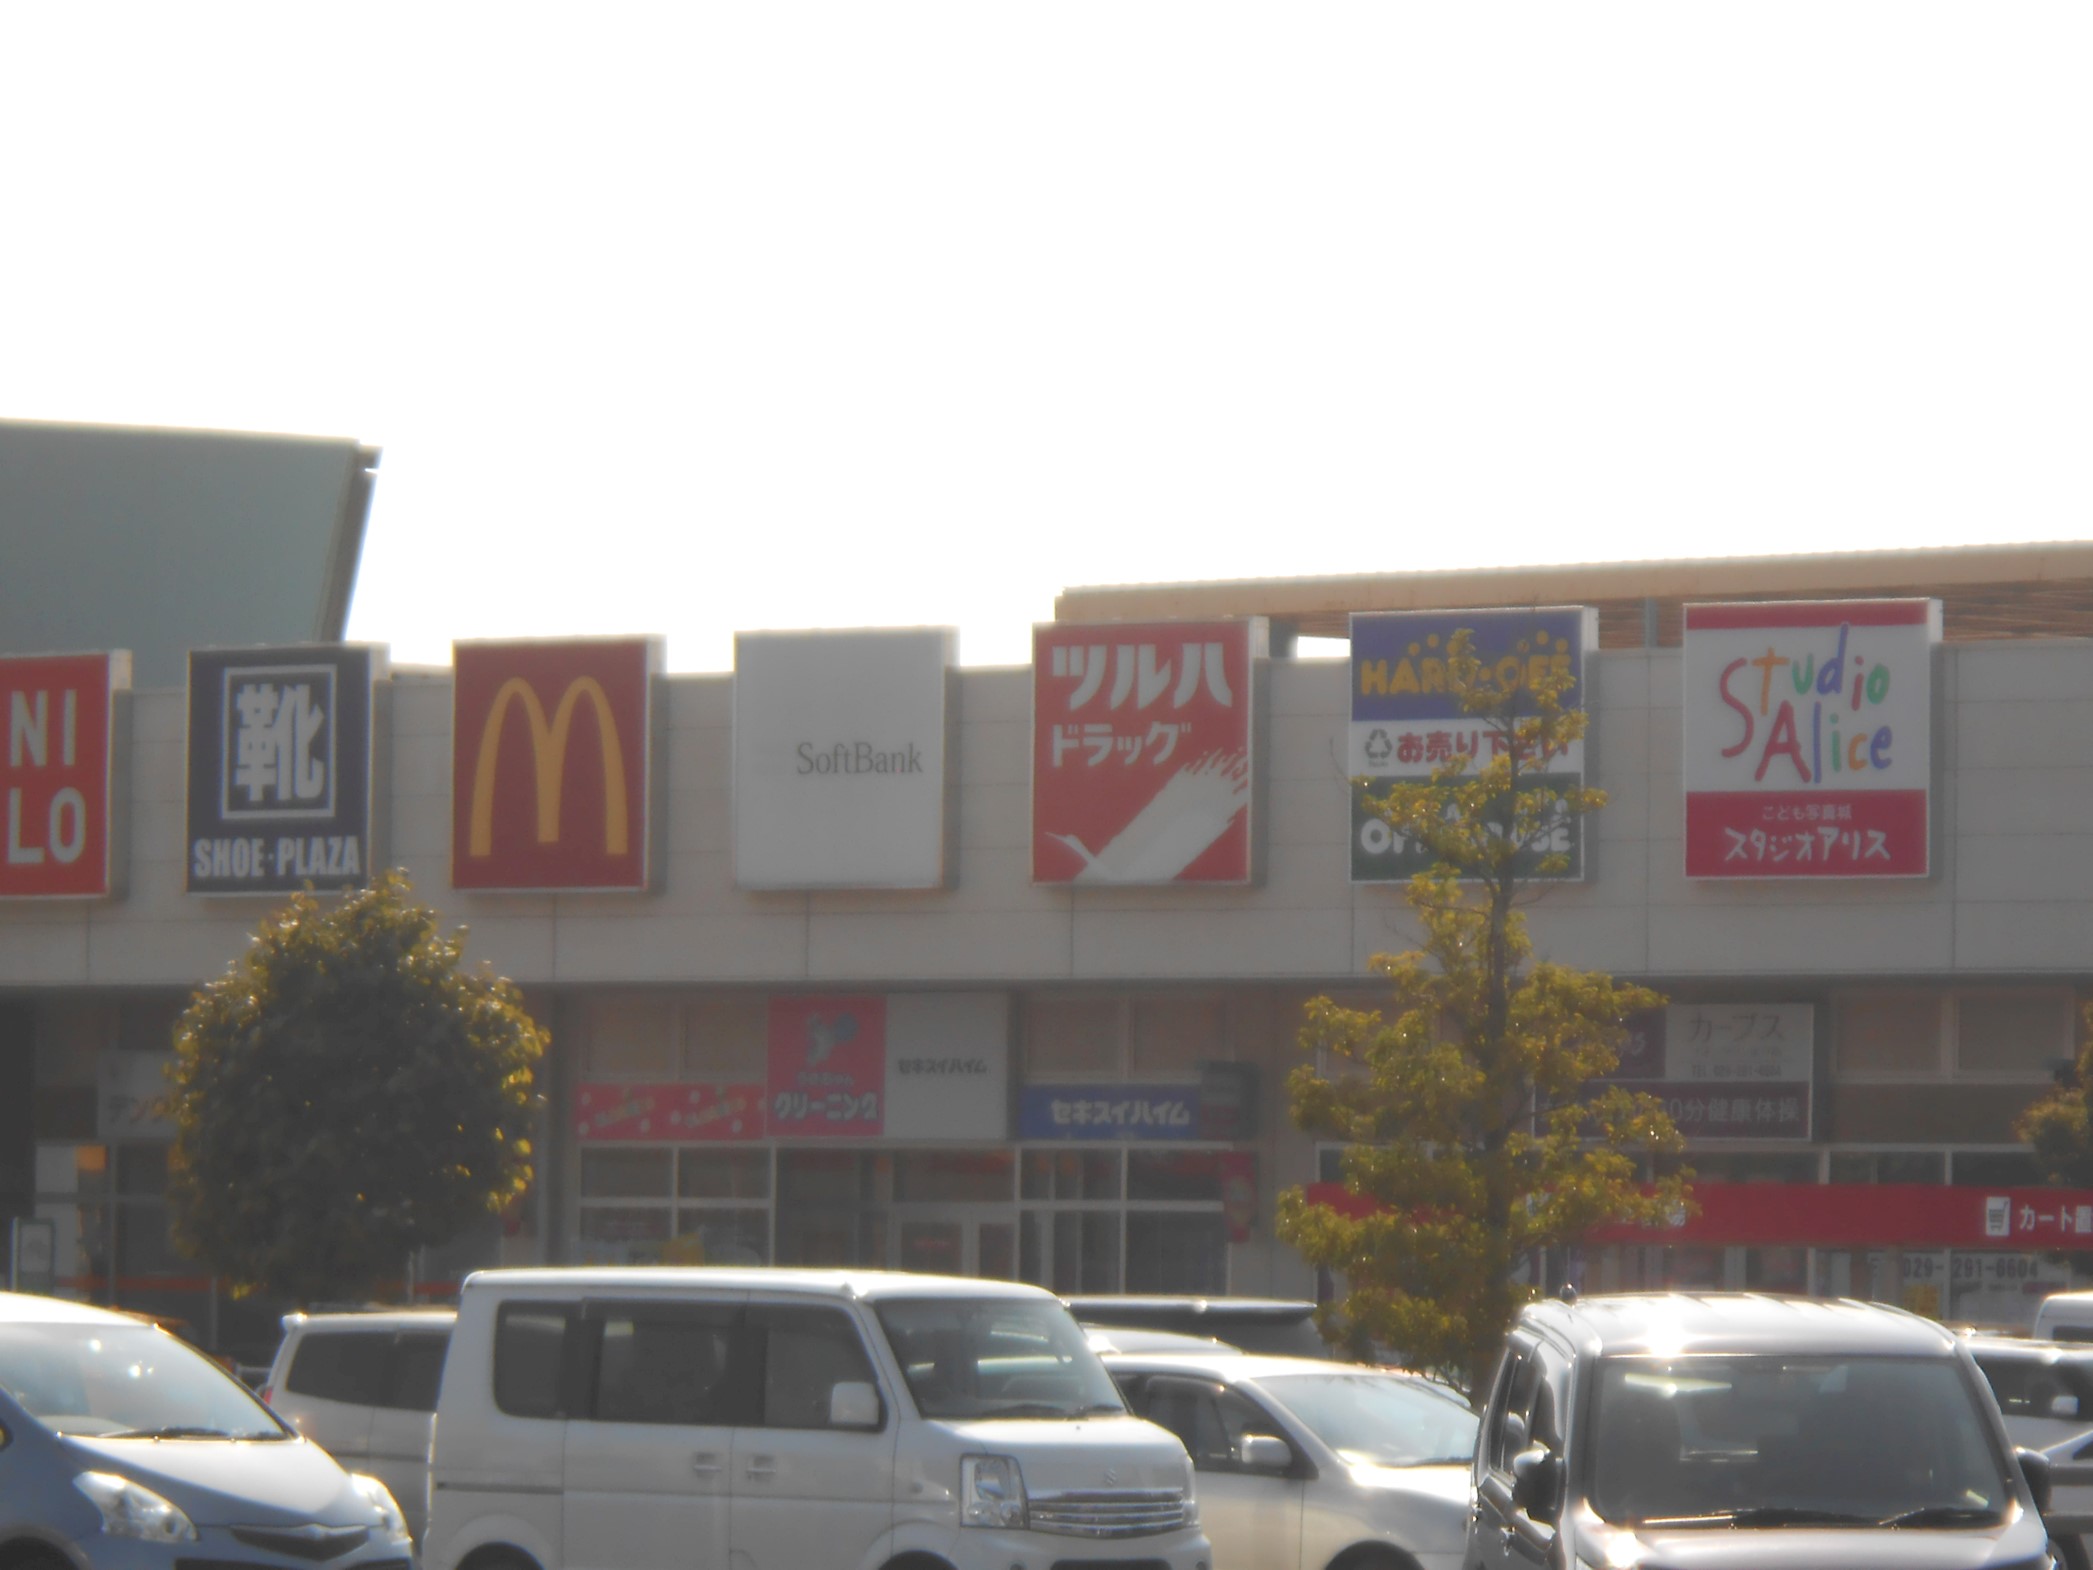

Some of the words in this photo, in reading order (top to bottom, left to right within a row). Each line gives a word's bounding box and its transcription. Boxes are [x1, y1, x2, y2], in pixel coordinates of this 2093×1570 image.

[1051, 642, 1233, 711] ツルハ
[1719, 621, 1891, 758] Studio
[10, 689, 77, 767] NI
[236, 683, 326, 802] 靴
[1052, 721, 1192, 768] ドラッグ
[1754, 699, 1893, 784] Alice
[797, 741, 923, 775] SoftBank
[8, 787, 86, 864] LO
[1724, 826, 1891, 862] スタジオアリス
[897, 1058, 988, 1075] セキスイハイム
[774, 1091, 879, 1120] クリーニング
[1050, 1098, 1191, 1125] セキスイハイム
